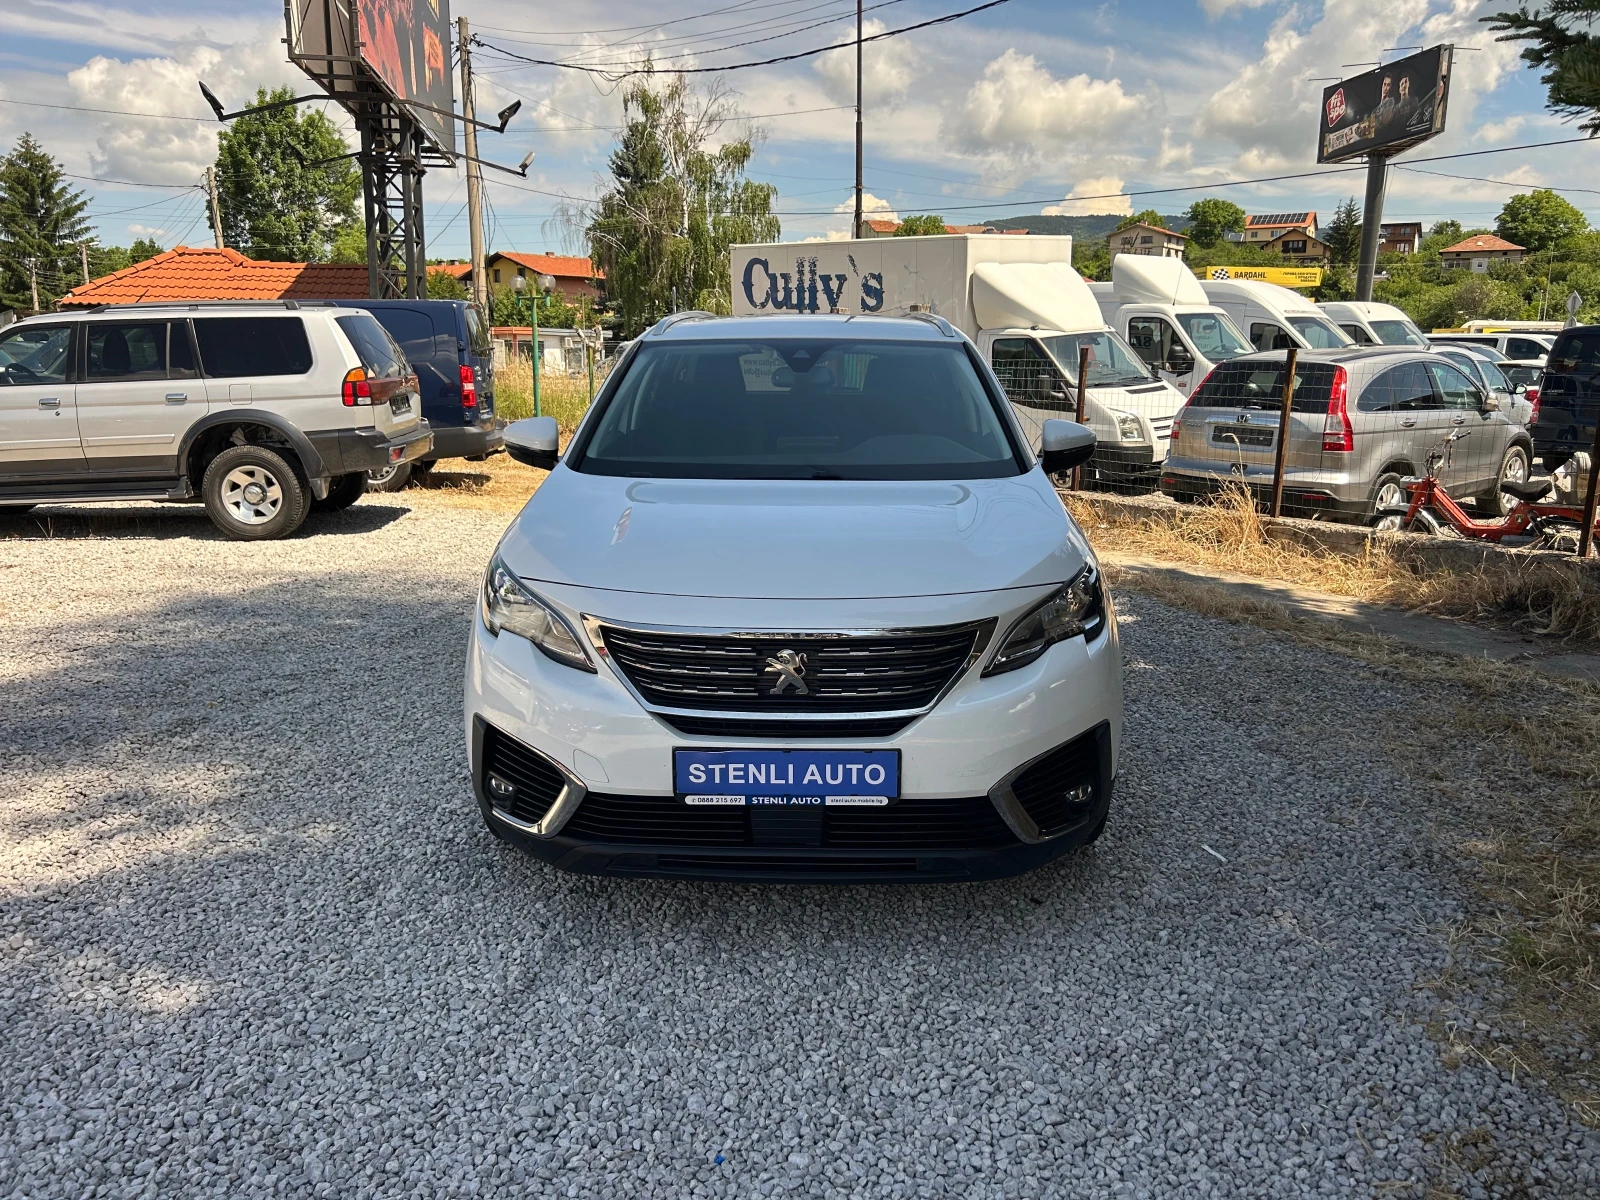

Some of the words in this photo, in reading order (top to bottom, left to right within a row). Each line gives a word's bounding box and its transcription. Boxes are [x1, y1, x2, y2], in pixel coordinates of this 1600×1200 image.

[1234, 271, 1267, 279] BARDAHL
[688, 763, 794, 784] STENLI
[802, 763, 886, 785] AUTO
